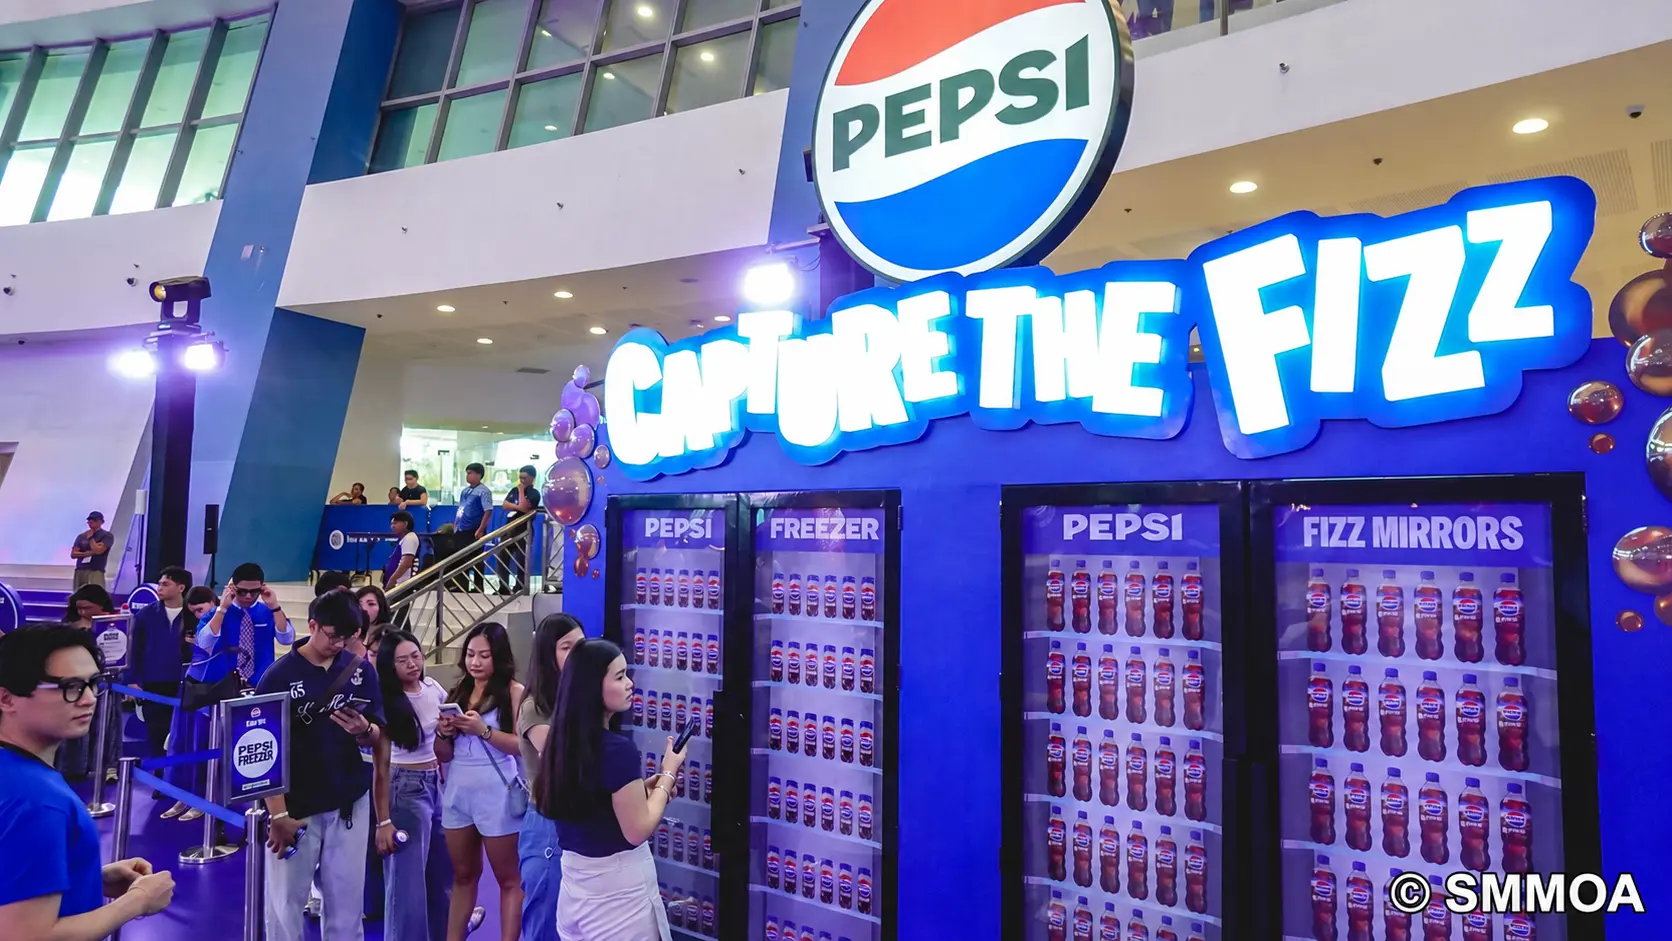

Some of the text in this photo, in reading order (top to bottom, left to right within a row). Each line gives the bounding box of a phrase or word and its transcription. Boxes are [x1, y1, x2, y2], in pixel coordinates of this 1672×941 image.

[832, 33, 1090, 172] PEPSI
[604, 200, 1554, 465] CAPTURE THE FIZZ
[645, 517, 712, 538] PEPSI
[770, 517, 879, 540] FREEZER
[1063, 512, 1183, 541] PEPSI
[1303, 515, 1524, 550] FIZZ MIRRORS
[290, 684, 306, 699] 65
[238, 740, 273, 756] PEPSI
